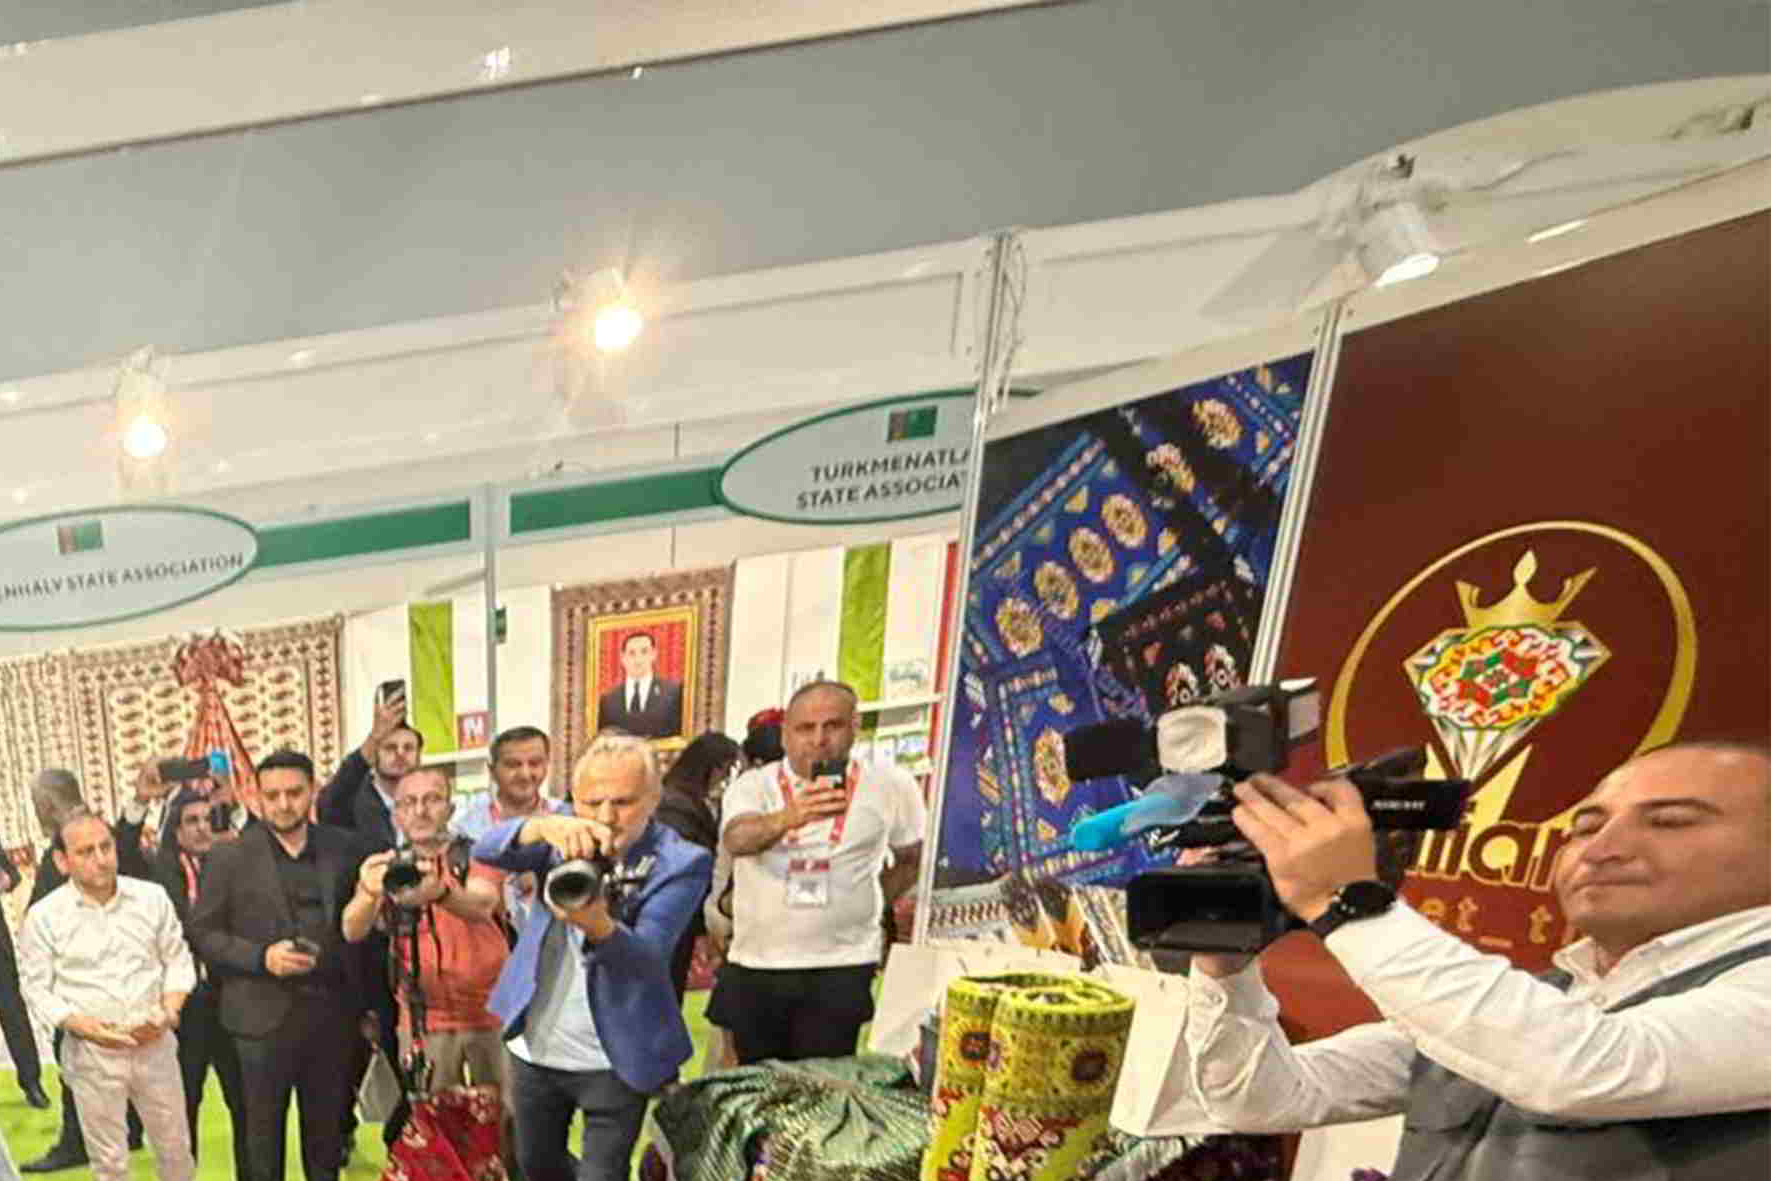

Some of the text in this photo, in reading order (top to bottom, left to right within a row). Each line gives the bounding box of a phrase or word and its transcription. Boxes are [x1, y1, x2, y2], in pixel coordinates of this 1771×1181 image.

[796, 485, 860, 510] STATE
[66, 566, 117, 592] STATE
[122, 552, 245, 583] ASSOCIATION
